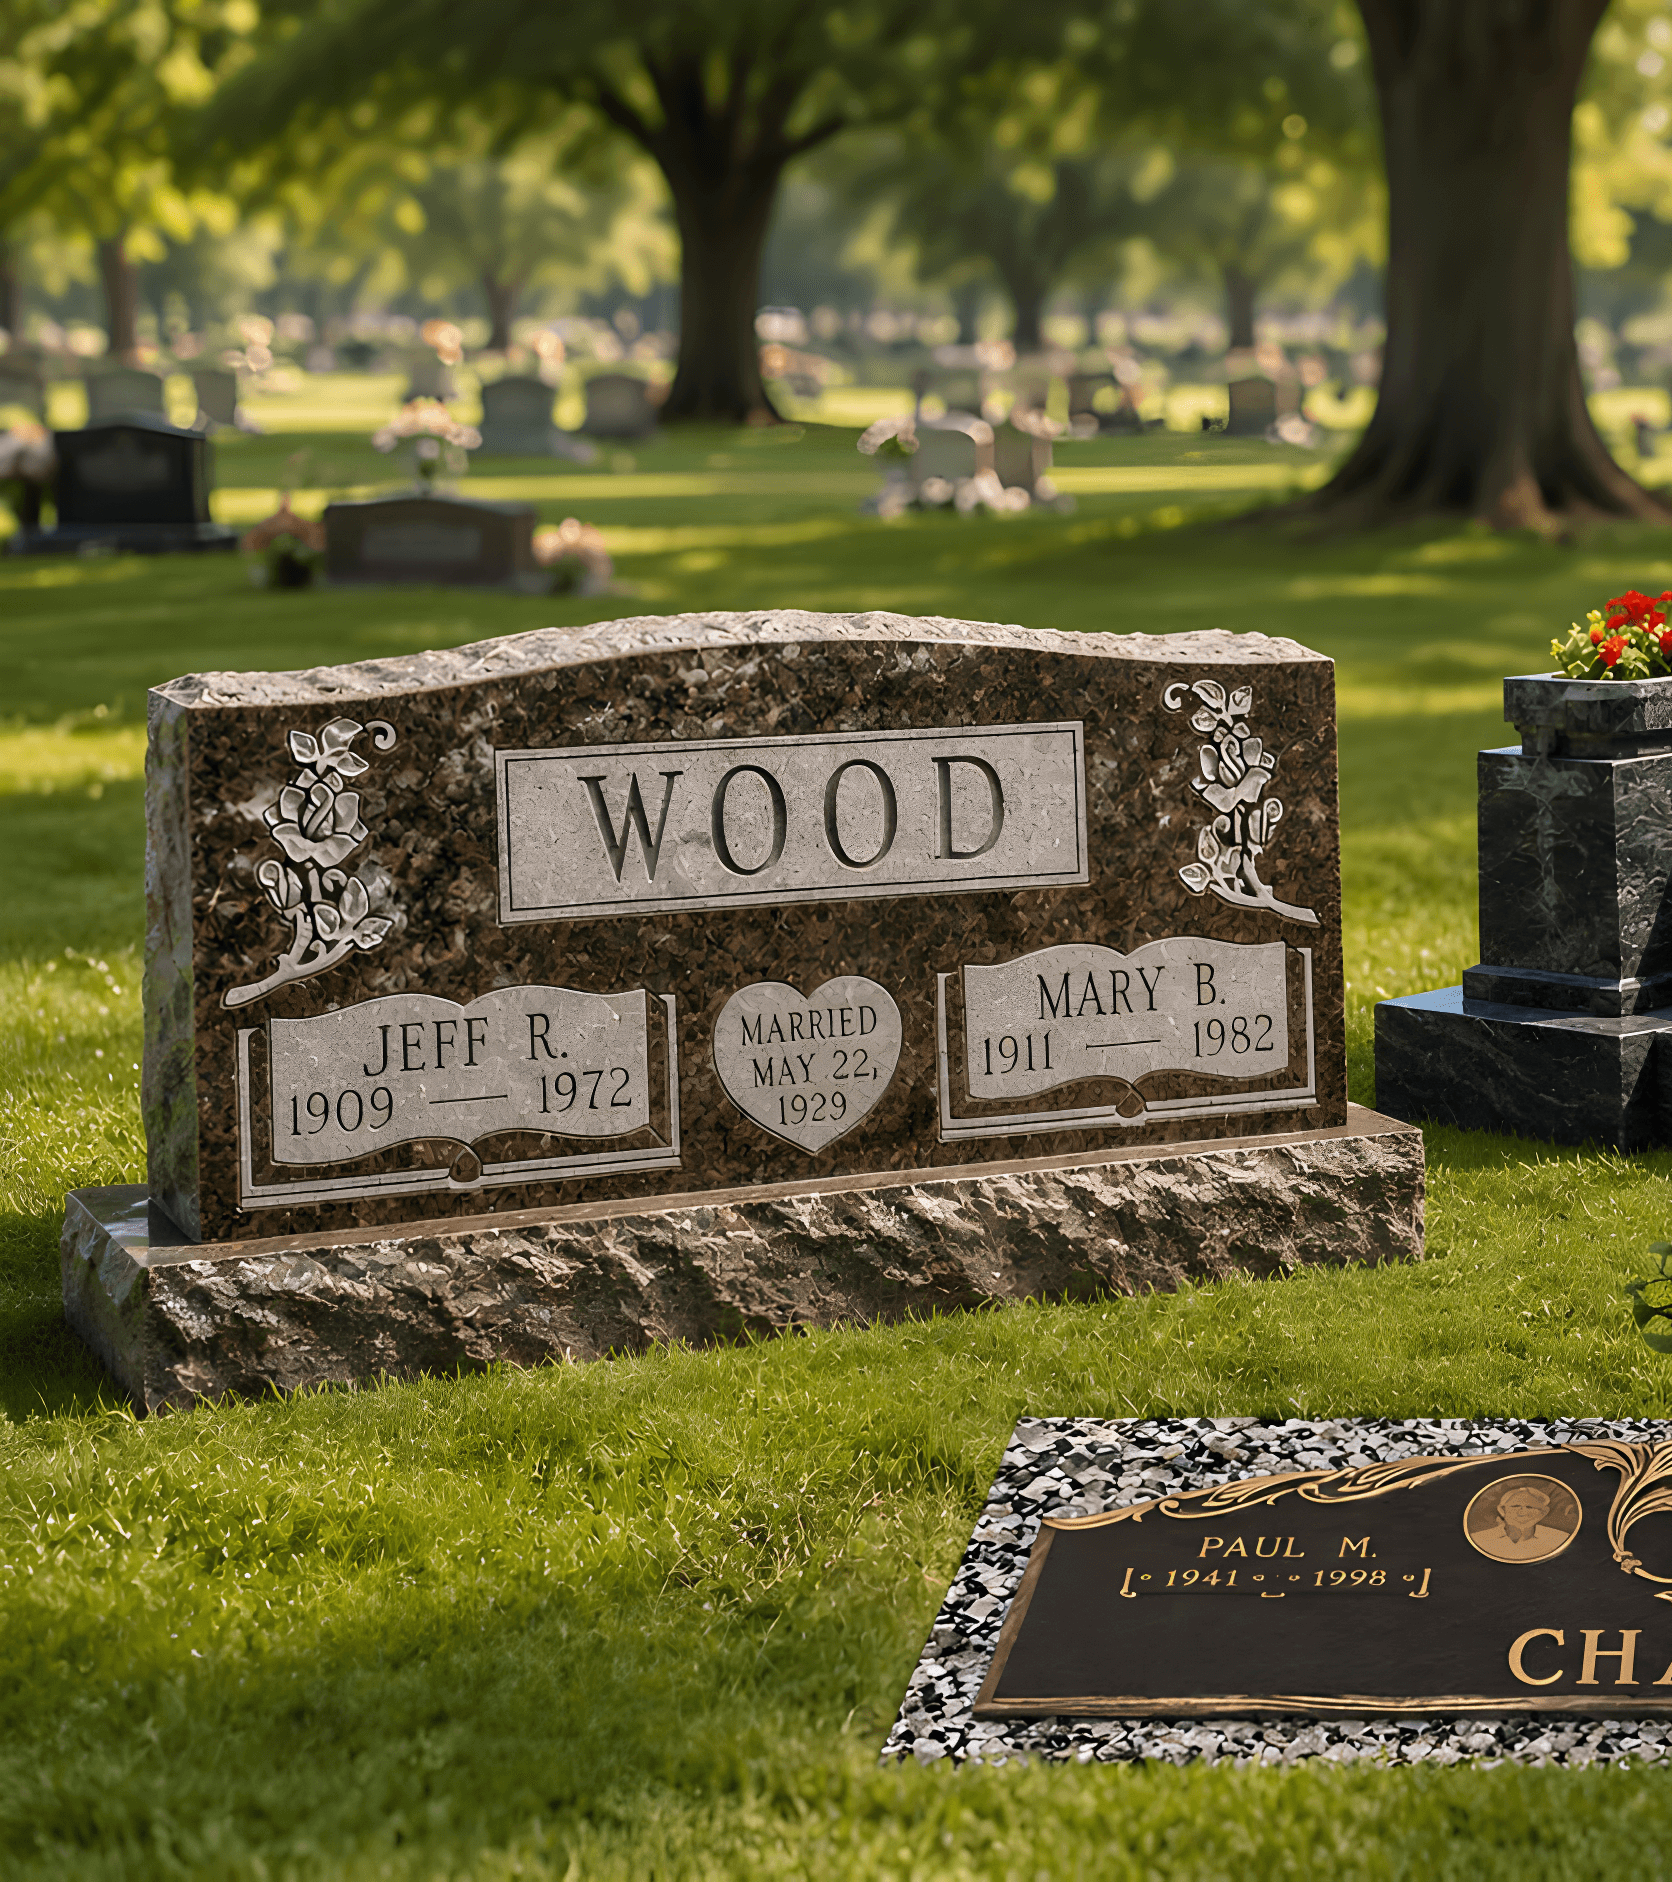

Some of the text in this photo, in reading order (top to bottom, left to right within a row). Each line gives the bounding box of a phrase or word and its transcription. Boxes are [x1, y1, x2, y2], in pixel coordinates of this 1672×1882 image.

[578, 755, 1006, 883] WOOD
[1036, 962, 1227, 1021] MARY B.
[364, 1012, 569, 1077] JEFF R.
[739, 1004, 878, 1047] MARRIED
[982, 1032, 1054, 1076] 1911
[1192, 1015, 1275, 1058] 1982
[752, 1047, 878, 1086] MAY 22,
[289, 1086, 395, 1136] 1909
[538, 1068, 633, 1114] 1972
[777, 1092, 849, 1126] 1929
[1197, 1536, 1378, 1558] PAUL M.
[1165, 1570, 1387, 1588] 1941 1998
